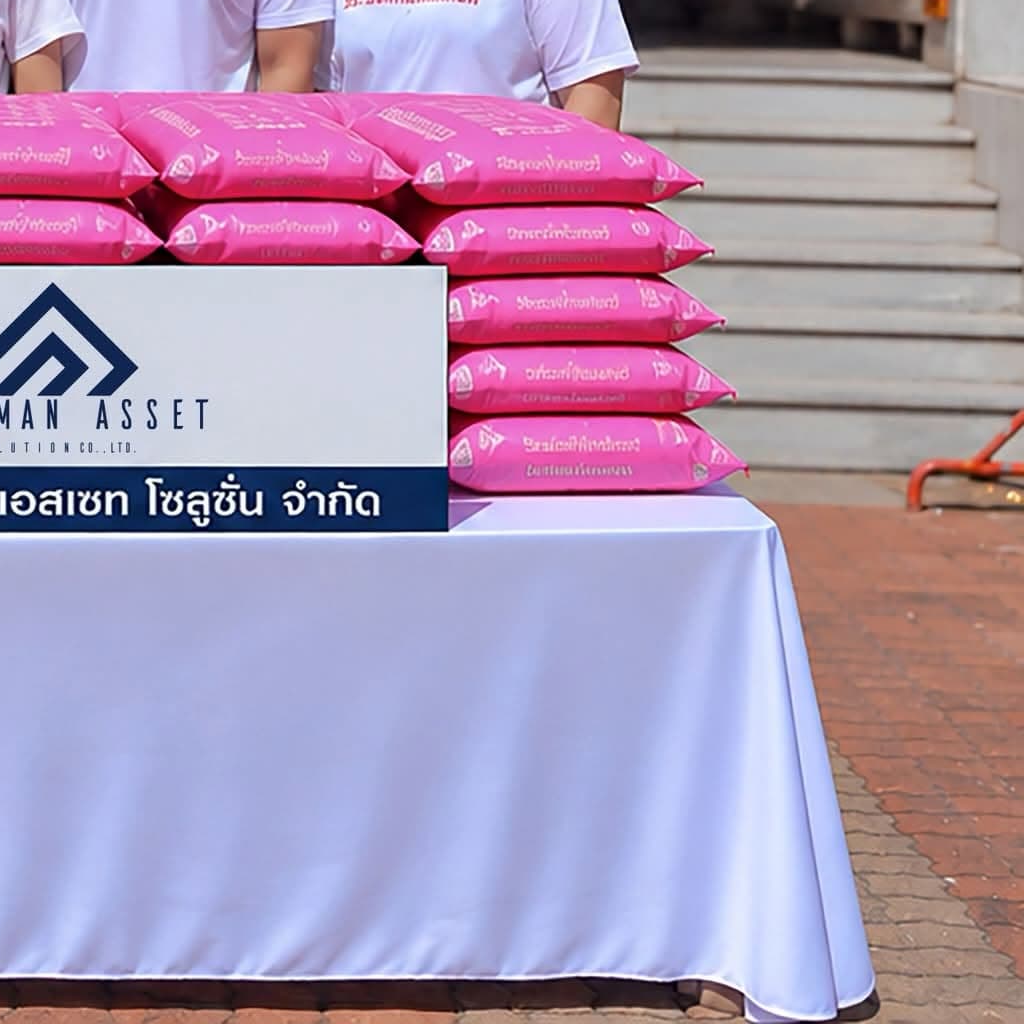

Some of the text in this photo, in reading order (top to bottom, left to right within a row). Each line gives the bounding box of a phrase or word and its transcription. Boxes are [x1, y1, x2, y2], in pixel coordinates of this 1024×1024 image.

[95, 399, 210, 430] ASSET
[144, 473, 264, 528] โซลูชั่น
[281, 479, 381, 517] จำกัด
